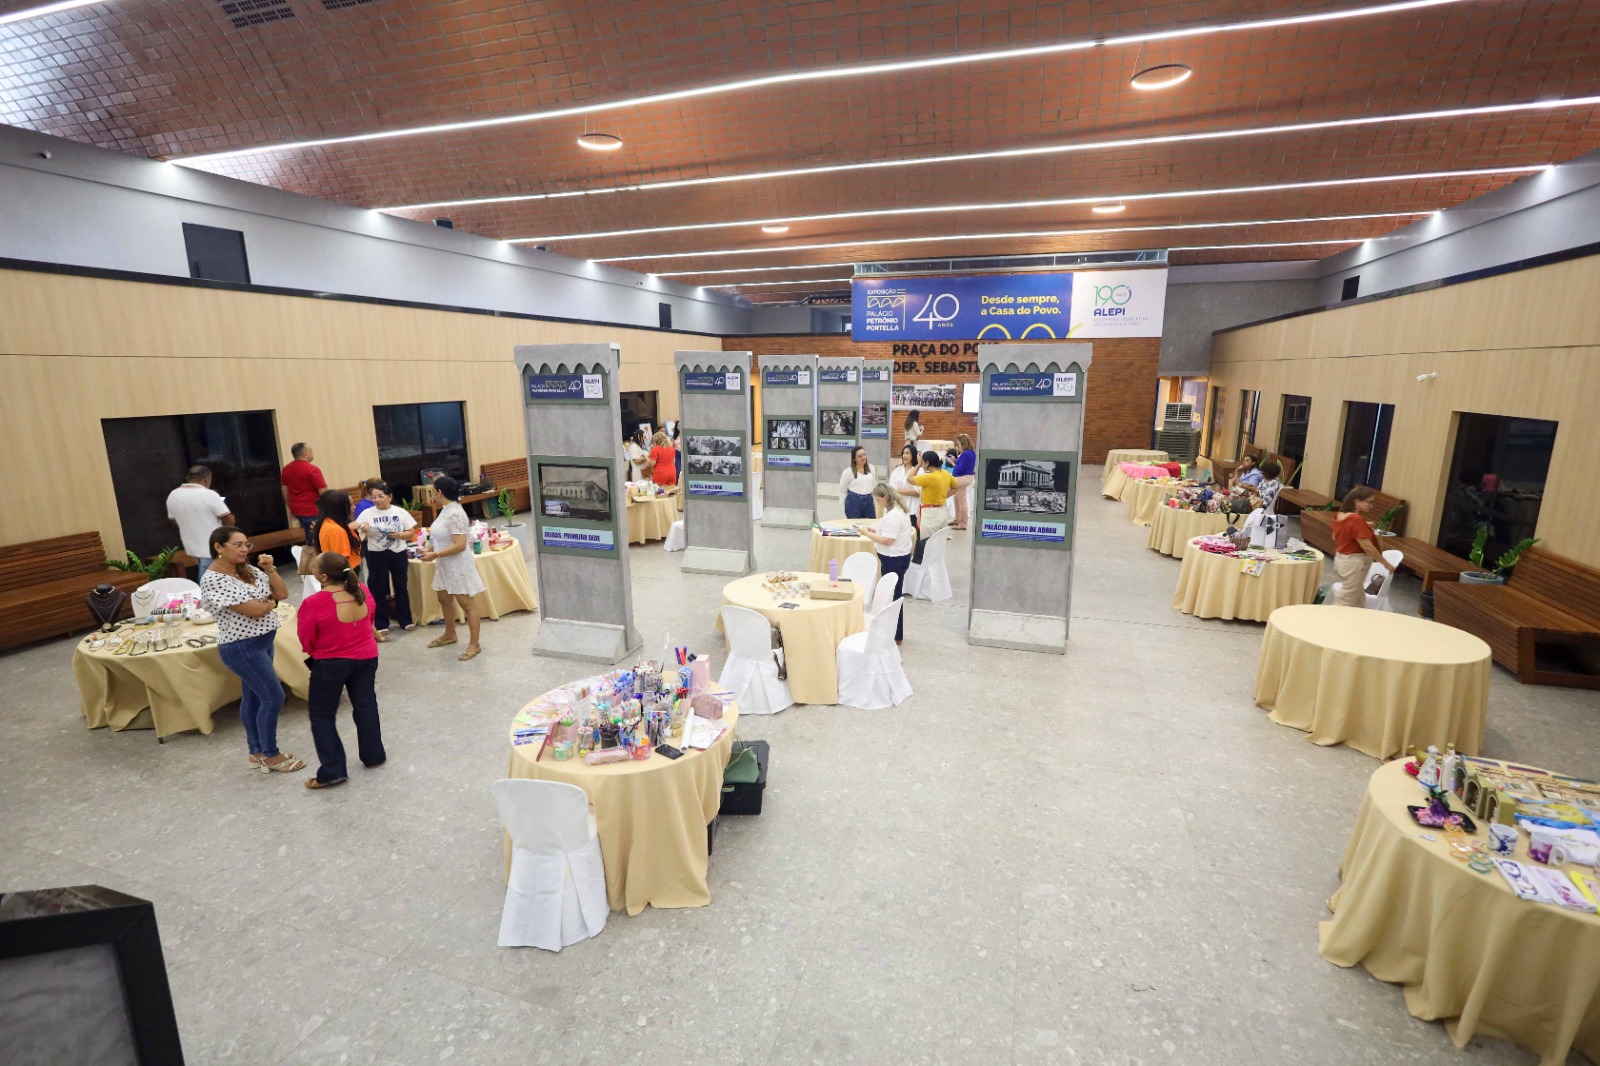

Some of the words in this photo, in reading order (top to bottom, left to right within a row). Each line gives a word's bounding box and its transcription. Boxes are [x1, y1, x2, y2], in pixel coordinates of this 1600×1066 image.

[981, 294, 1015, 305] Desde
[1016, 294, 1060, 306] sempre,
[1094, 284, 1132, 306] 190
[866, 309, 894, 317] PALÁCIO
[912, 293, 960, 330] 40
[980, 308, 988, 316] a
[989, 306, 1015, 315] Casa
[1016, 305, 1031, 315] do
[1033, 305, 1062, 315] Povo.
[1093, 307, 1126, 317] ALEPI
[866, 316, 899, 325] PETRÔNIO
[892, 343, 937, 358] PRAÇA
[940, 343, 959, 355] DO
[893, 361, 920, 373] DEP.
[1035, 378, 1052, 391] 40
[984, 523, 1008, 531] PALÁCIO
[1008, 524, 1029, 533] ANÍSIO
[1037, 526, 1057, 534] ABREU
